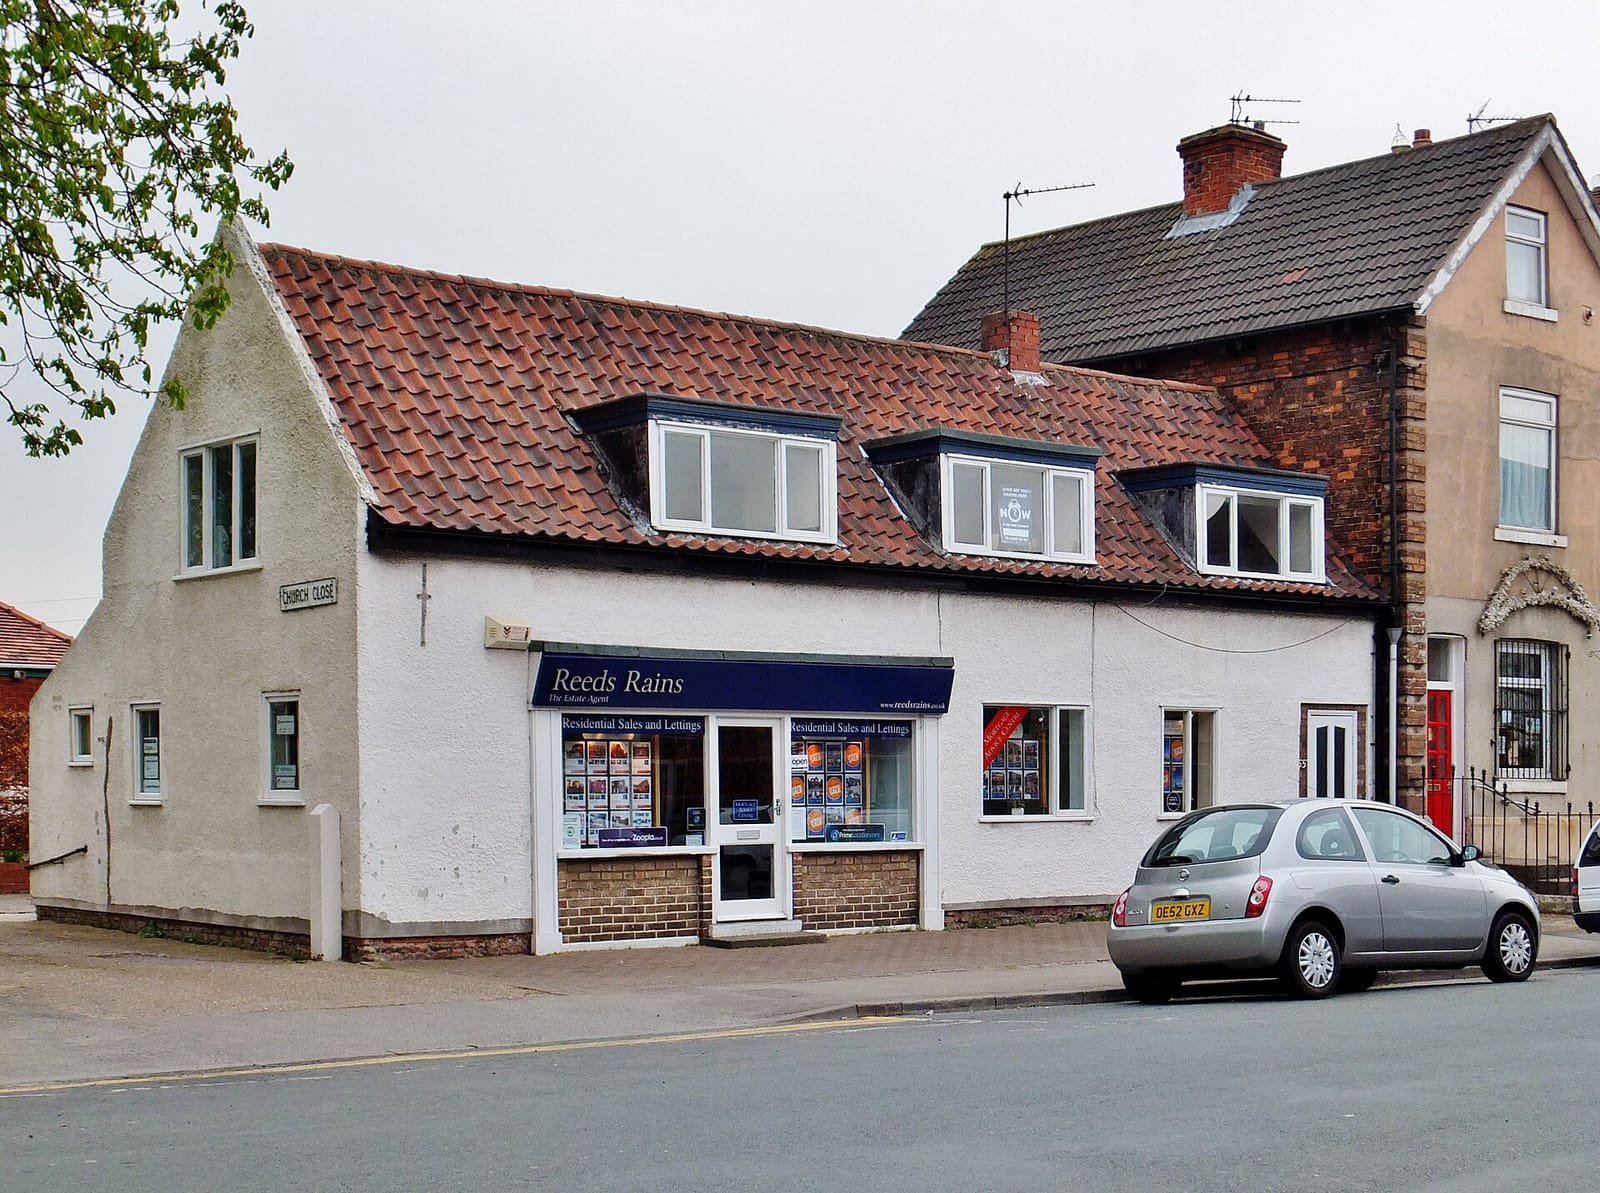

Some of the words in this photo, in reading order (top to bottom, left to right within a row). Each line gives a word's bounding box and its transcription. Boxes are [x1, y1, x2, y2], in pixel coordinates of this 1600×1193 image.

[282, 588, 308, 604] CHURCH
[312, 583, 334, 600] CLOSE
[551, 668, 617, 692] Reeds
[623, 670, 684, 694] Rains
[549, 694, 562, 702] The
[564, 694, 586, 702] Estate
[586, 695, 609, 704] Agent
[880, 700, 945, 709] www.reedsrains.co.uk
[562, 717, 615, 729] Residential
[618, 718, 642, 730] Sales
[645, 719, 662, 730] and
[664, 719, 702, 733] Lettings
[790, 721, 836, 733] Residential
[837, 722, 859, 733] Sales
[861, 723, 875, 734] and
[878, 723, 910, 736] Lettings
[791, 758, 808, 767] open
[1184, 903, 1204, 917] GXZ
